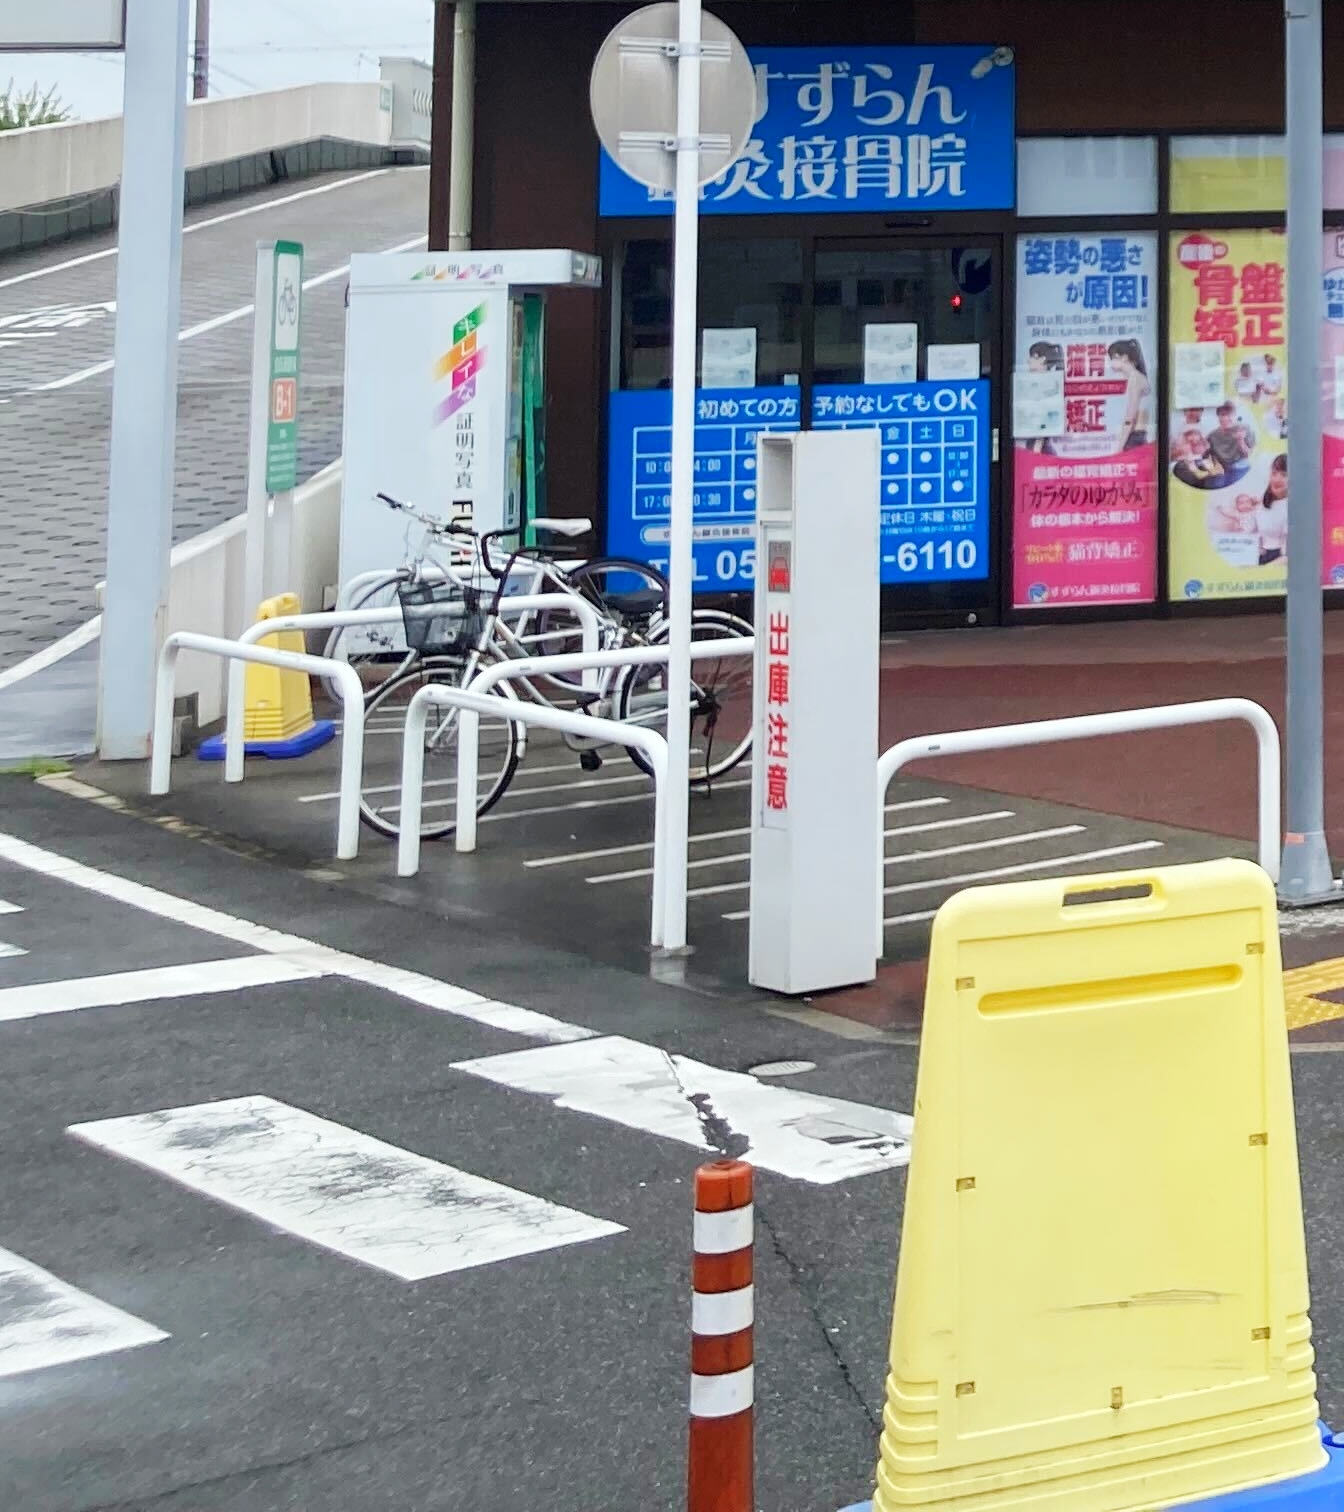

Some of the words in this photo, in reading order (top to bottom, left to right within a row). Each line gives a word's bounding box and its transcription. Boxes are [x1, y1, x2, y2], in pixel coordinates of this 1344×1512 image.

[1024, 238, 1144, 276] 姿勢の悪さ
[1193, 261, 1286, 307] 骨盤
[1194, 306, 1286, 349] 矯正
[698, 396, 800, 420] 初めての方
[765, 609, 791, 811] 出庫注意
